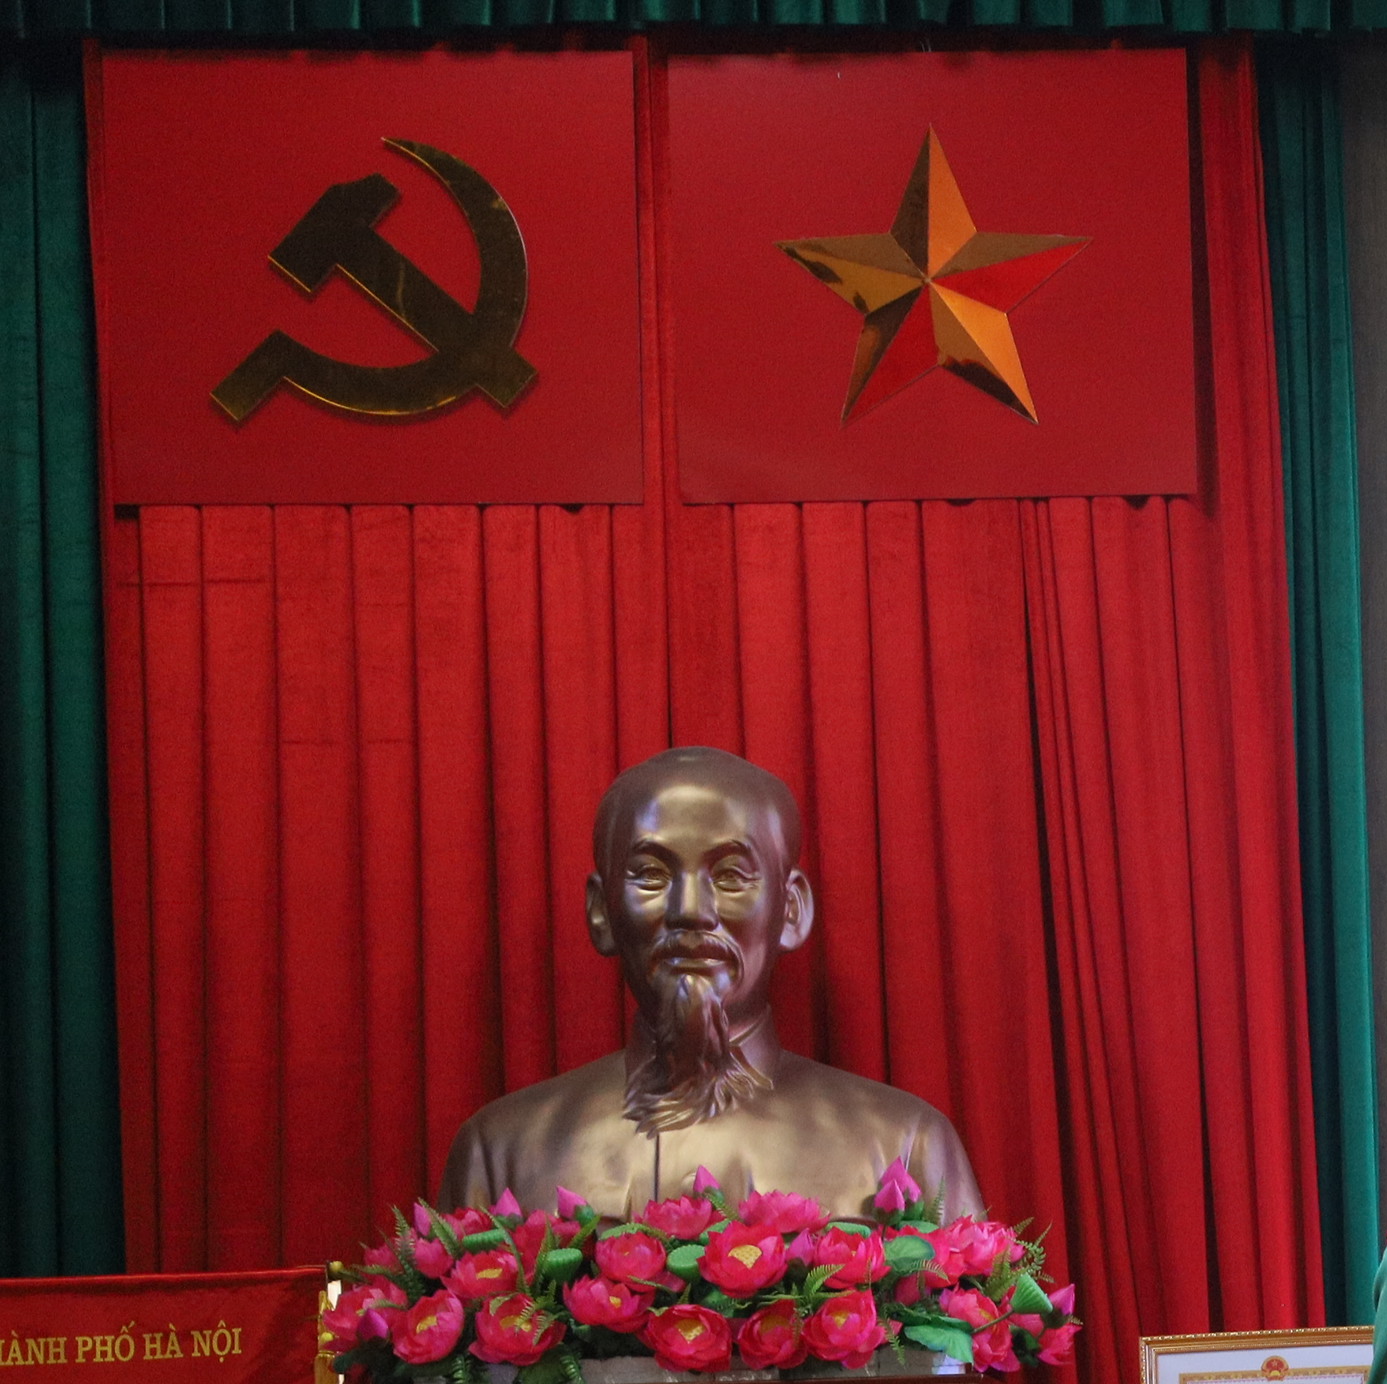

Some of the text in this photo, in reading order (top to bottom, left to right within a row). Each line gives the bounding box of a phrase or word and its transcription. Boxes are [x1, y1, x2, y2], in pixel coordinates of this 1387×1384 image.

[75, 1321, 135, 1363] PHỐ
[143, 1323, 184, 1360] HÀ
[191, 1320, 242, 1363] NỘI
